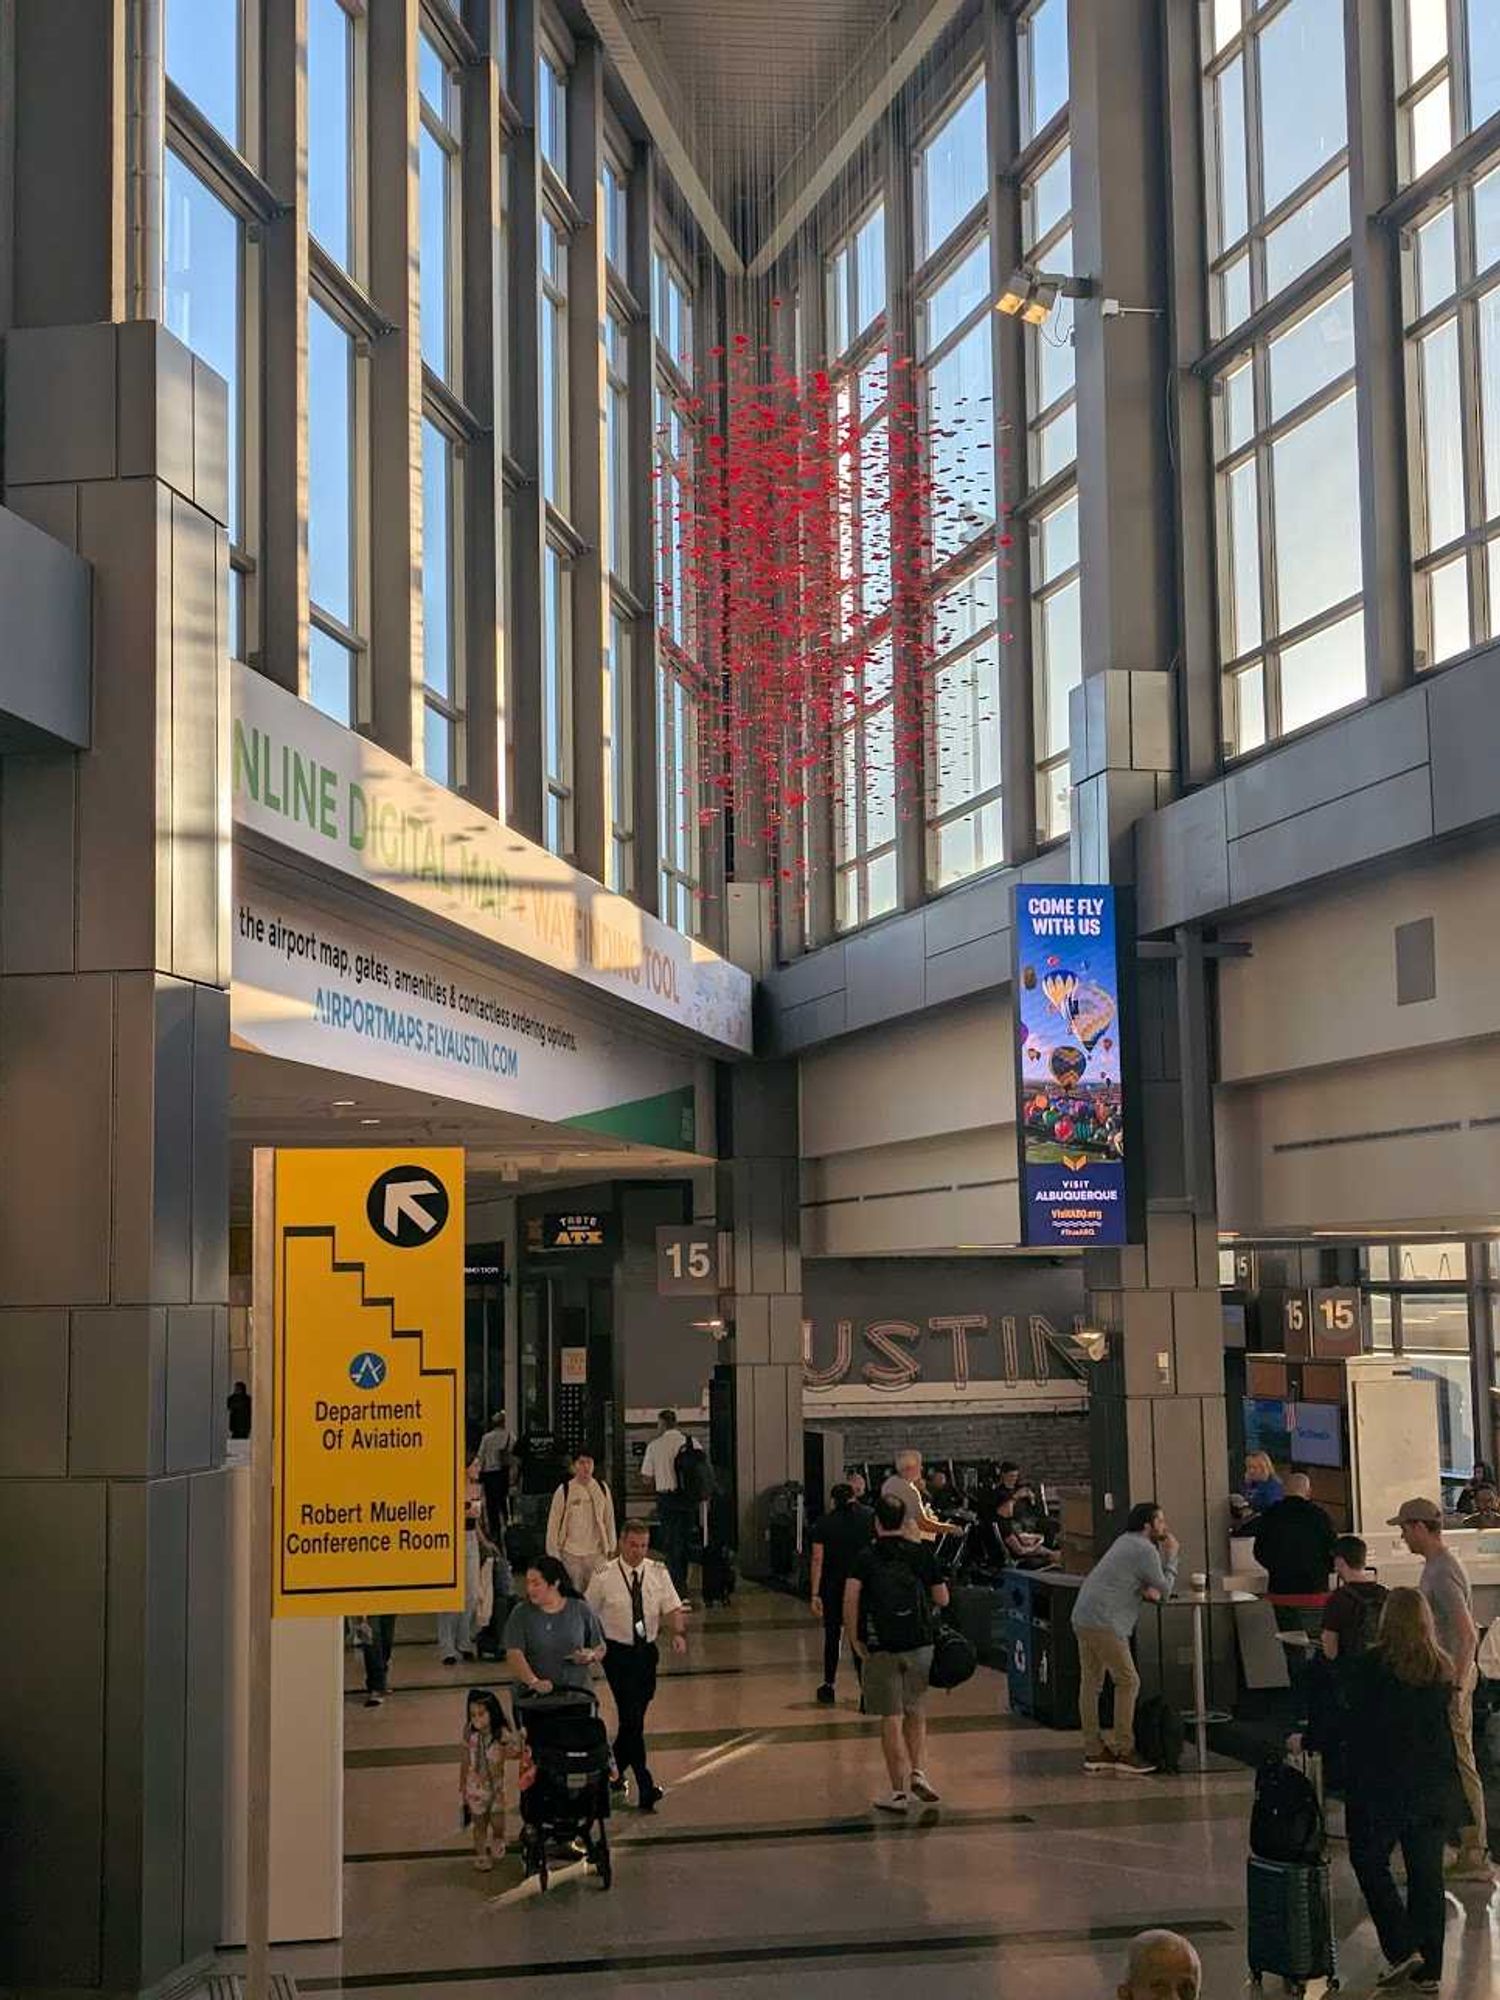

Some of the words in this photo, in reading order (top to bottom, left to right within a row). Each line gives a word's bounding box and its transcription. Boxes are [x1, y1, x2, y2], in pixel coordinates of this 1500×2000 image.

[234, 718, 337, 840] NLINE
[643, 945, 680, 1005] TOOL
[1028, 898, 1075, 915] COME
[1078, 898, 1104, 915] FLY
[1032, 917, 1075, 935] WITH
[1078, 918, 1101, 935] US
[239, 906, 264, 942] the
[268, 917, 316, 960] airport
[320, 942, 352, 977] map,
[355, 953, 392, 990] gates,
[395, 969, 446, 1008] amenities
[449, 984, 456, 1009] &
[458, 992, 510, 1028] contactless
[511, 1010, 545, 1047] ordering
[313, 987, 518, 1077] AIRPORTMAPS.FLYAUSTIN.COM
[1035, 1190, 1118, 1201] ALBUQUERQUE
[1062, 1180, 1090, 1189] VISIT
[666, 1242, 710, 1278] 15
[1286, 1299, 1303, 1330] 15
[1320, 1299, 1354, 1329] 15
[315, 1400, 422, 1425] Department
[323, 1429, 344, 1450] Of
[351, 1428, 423, 1449] Aviation
[301, 1503, 363, 1525] Robert
[370, 1501, 436, 1523] Mueller
[286, 1532, 391, 1554] Conference
[399, 1529, 450, 1550] Room
